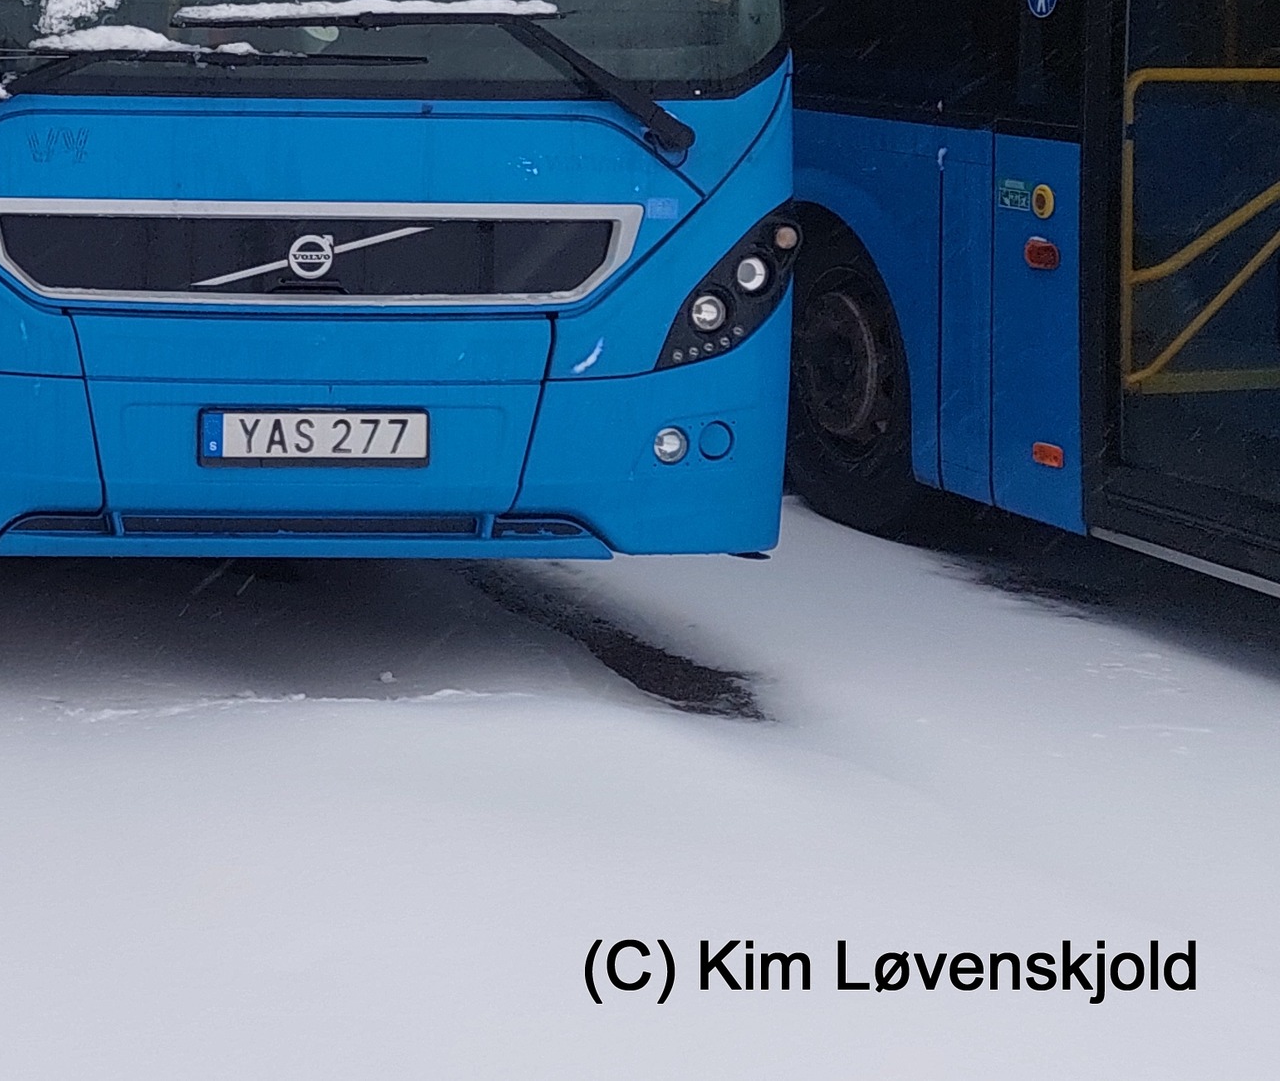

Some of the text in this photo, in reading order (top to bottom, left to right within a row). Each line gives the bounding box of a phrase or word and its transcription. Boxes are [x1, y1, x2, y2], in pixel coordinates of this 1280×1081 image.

[291, 253, 331, 261] VOLVO
[209, 418, 409, 454] S YAS 277
